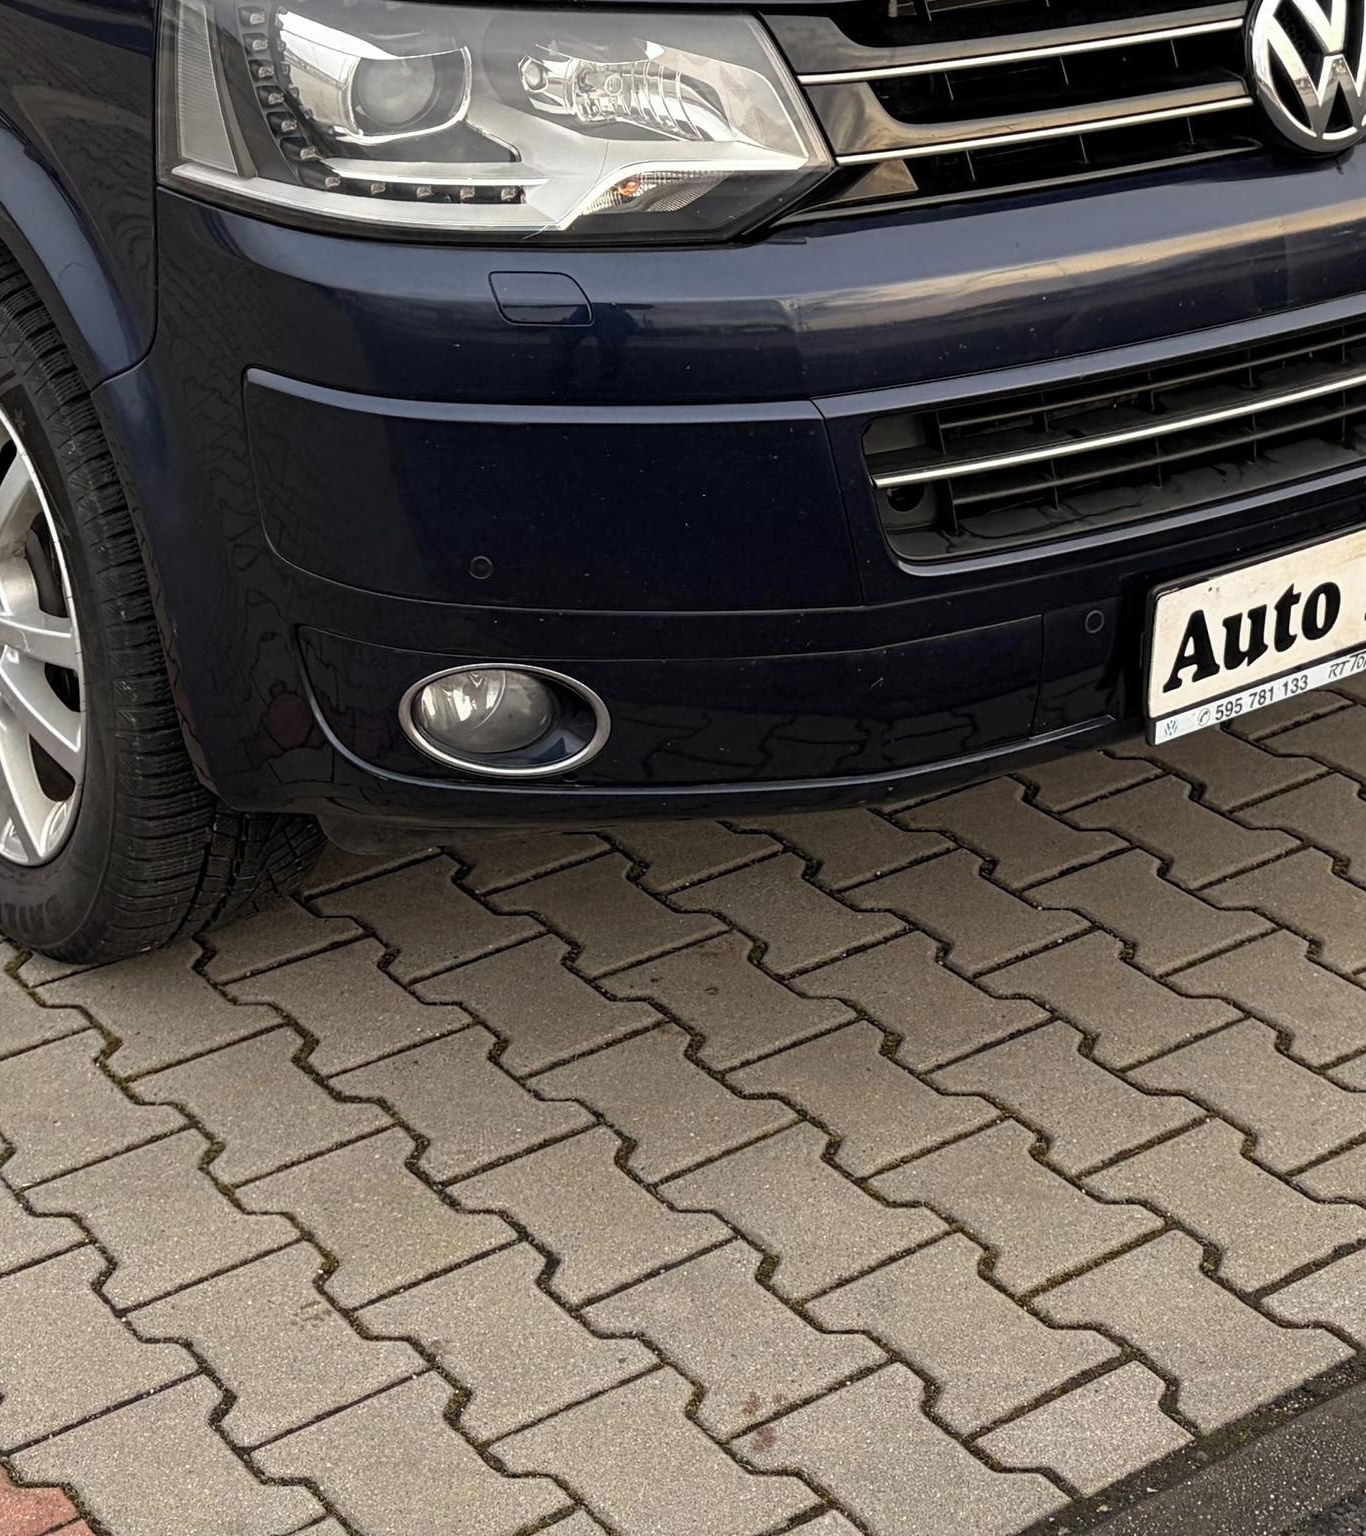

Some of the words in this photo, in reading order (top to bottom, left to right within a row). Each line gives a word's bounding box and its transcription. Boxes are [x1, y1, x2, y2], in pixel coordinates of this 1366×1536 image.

[1163, 581, 1341, 693] Auto
[1215, 697, 1243, 720] 595
[1249, 686, 1274, 708] 781
[1282, 675, 1308, 697] 133
[1328, 660, 1349, 678] RT
